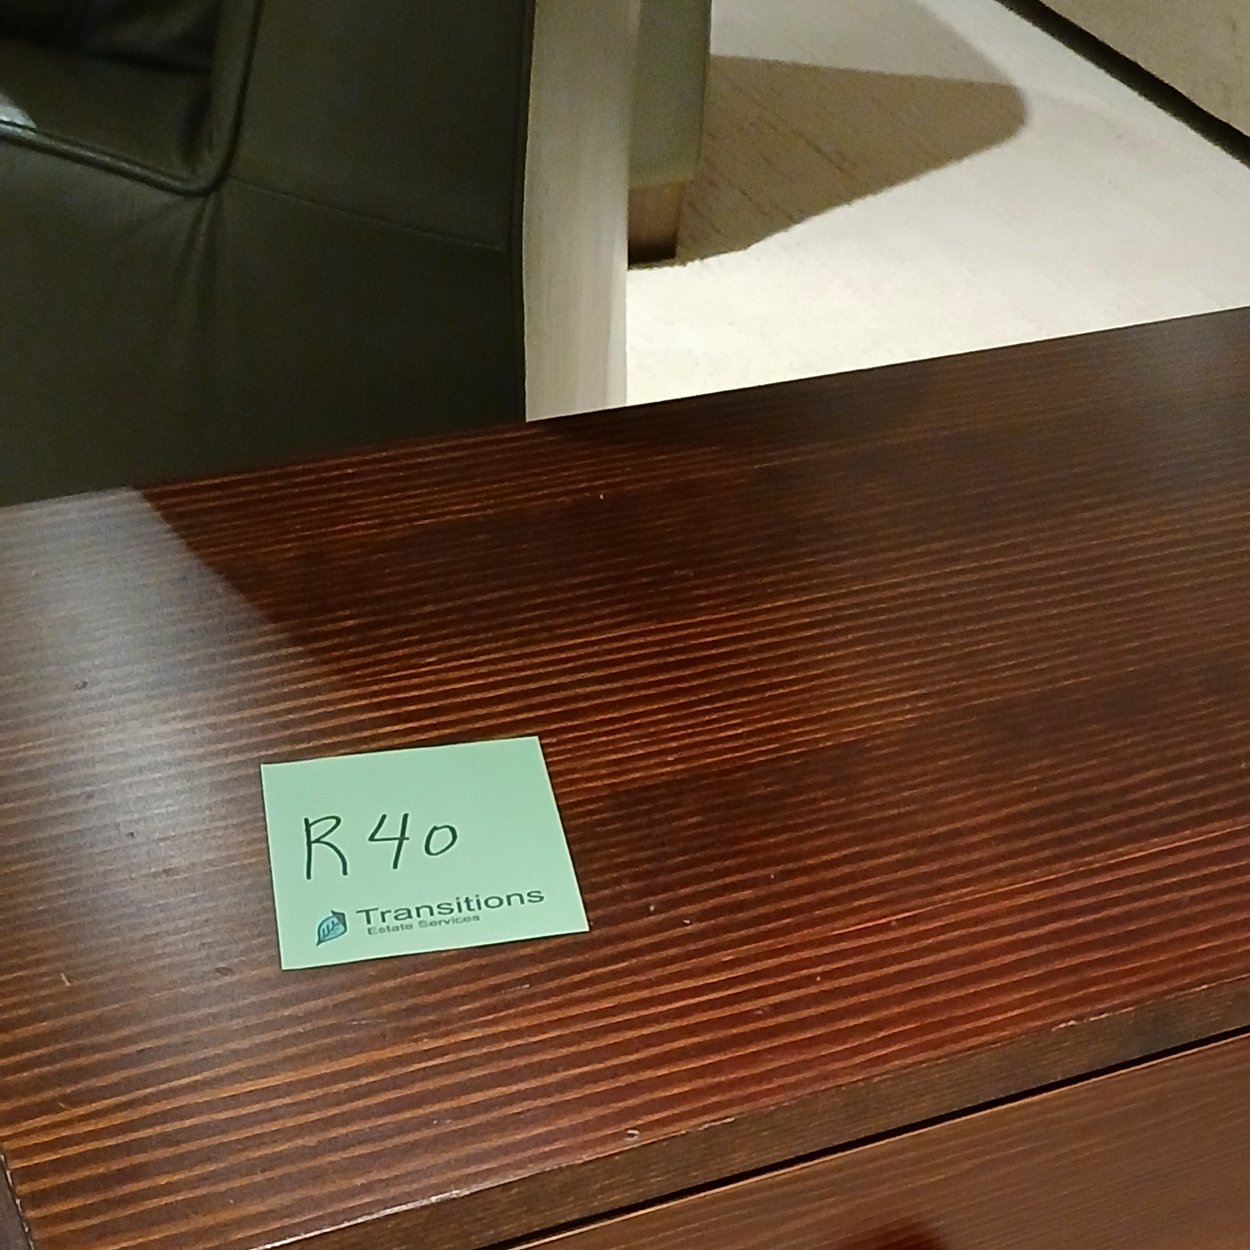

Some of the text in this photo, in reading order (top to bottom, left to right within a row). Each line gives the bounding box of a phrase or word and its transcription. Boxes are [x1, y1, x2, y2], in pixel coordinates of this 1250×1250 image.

[356, 889, 545, 926] Transitions
[367, 914, 481, 936] Estate Services
